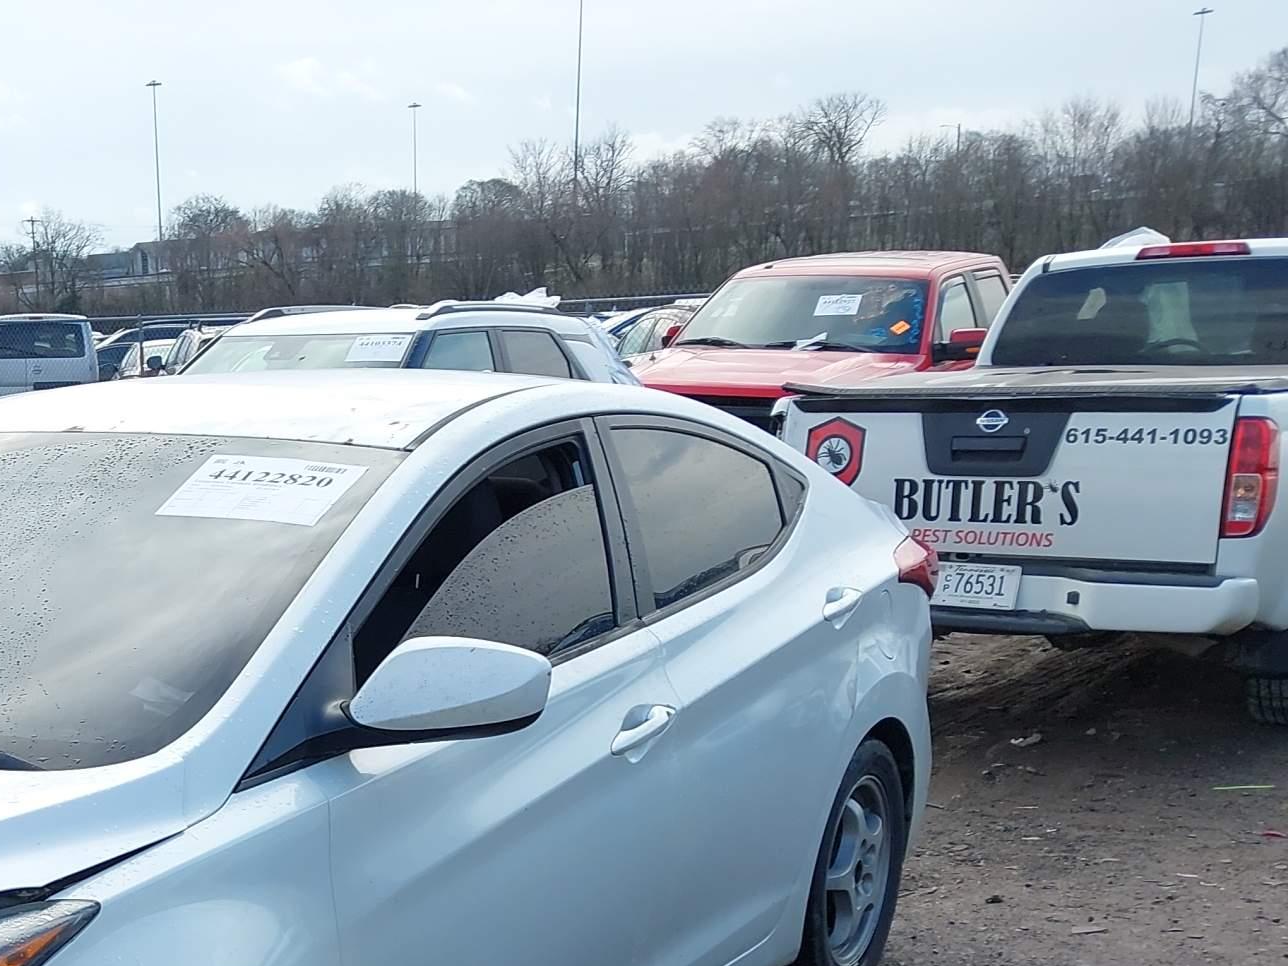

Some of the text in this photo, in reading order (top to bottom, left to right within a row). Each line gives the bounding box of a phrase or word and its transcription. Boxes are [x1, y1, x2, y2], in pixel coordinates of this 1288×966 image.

[1065, 427, 1229, 445] 615-441-1093
[208, 468, 334, 488] 44122820
[912, 528, 1054, 548] PEST SOLUTIONS
[954, 572, 1005, 597] 76531
